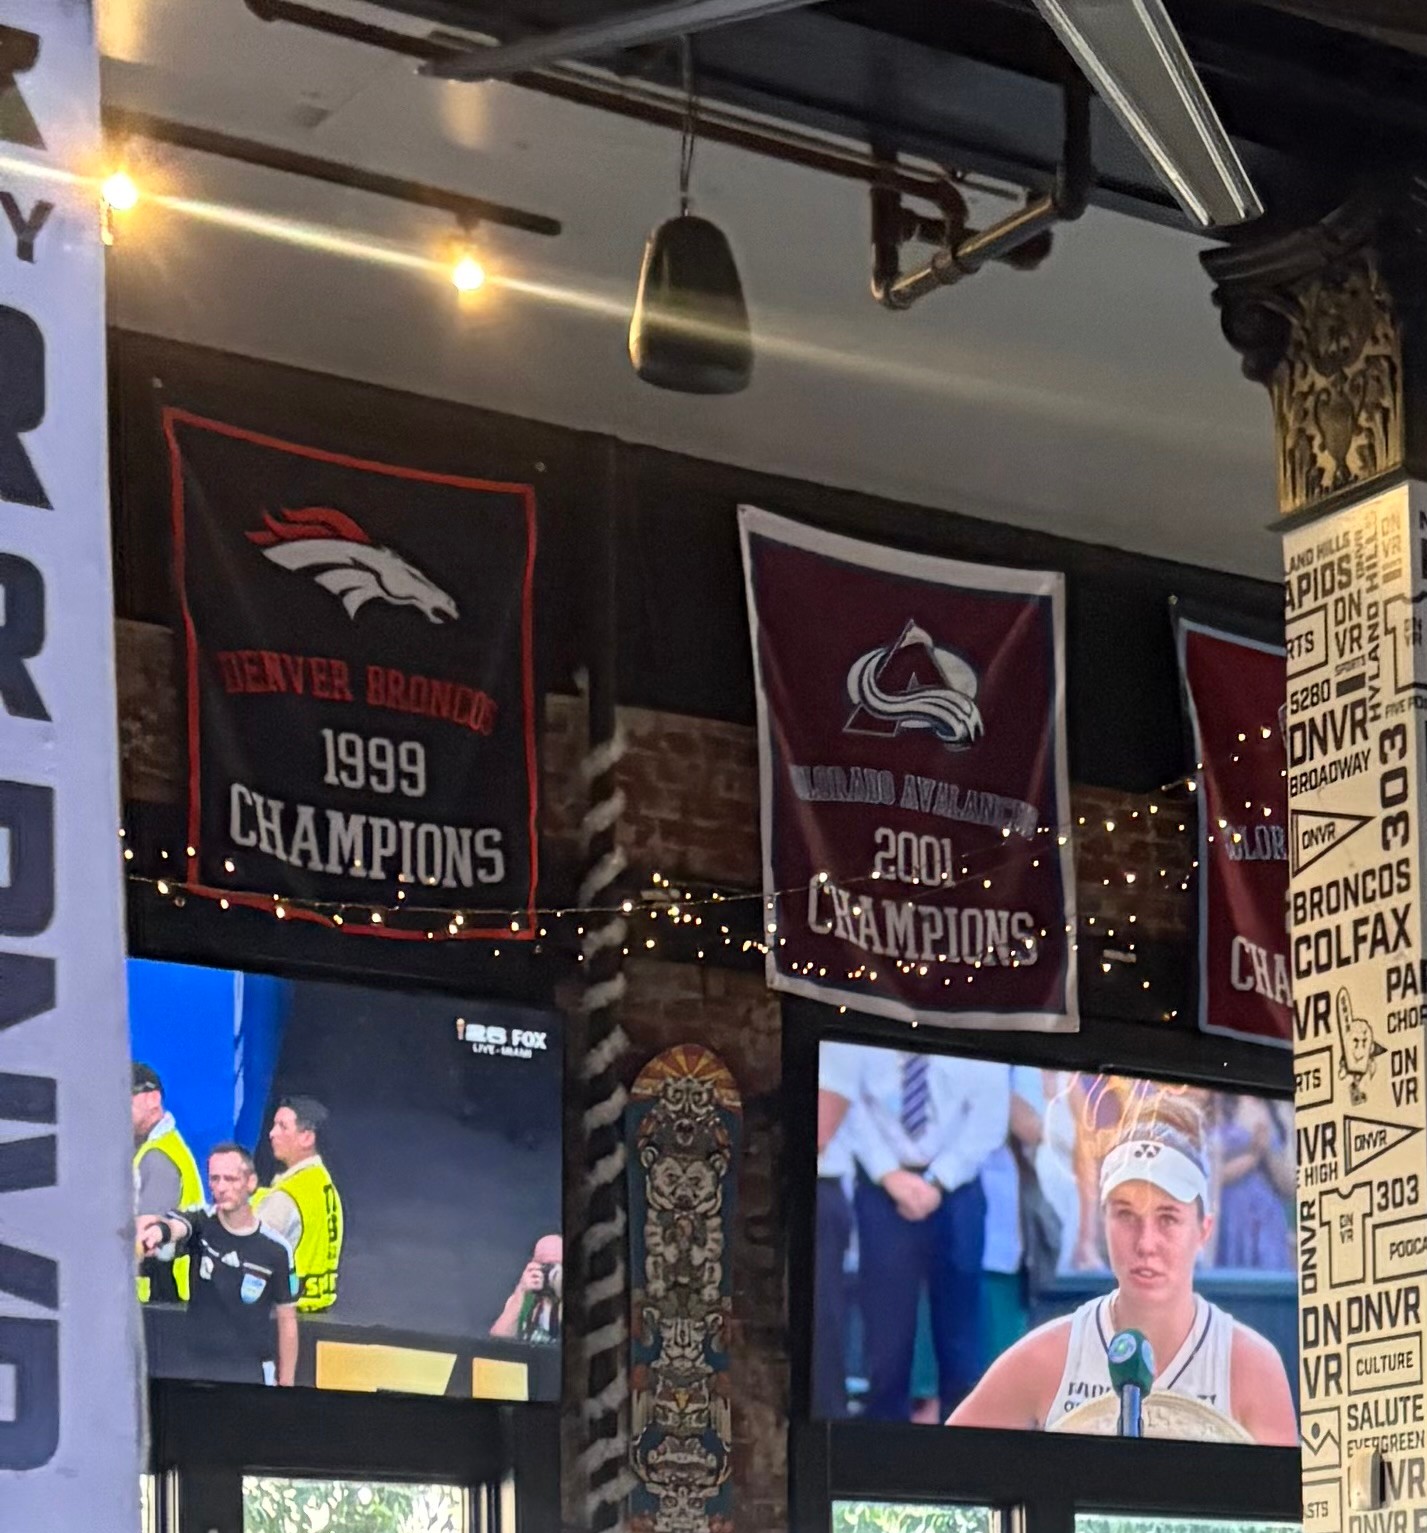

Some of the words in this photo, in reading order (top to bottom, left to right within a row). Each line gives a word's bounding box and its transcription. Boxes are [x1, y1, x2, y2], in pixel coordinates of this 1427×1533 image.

[217, 650, 353, 702] DENVER
[1290, 678, 1330, 715] 5280
[1289, 699, 1369, 767] DNVR
[321, 728, 426, 797] 1999
[1289, 749, 1371, 797] BROADWAY
[1380, 724, 1409, 851] 303
[230, 783, 505, 888] CHAMPIONS
[874, 827, 956, 887] 2001
[808, 874, 1038, 966] CHAMPIONS
[1293, 857, 1411, 927] BRONCOS
[1294, 903, 1412, 981] COLFAX
[512, 1029, 547, 1050] FOX
[1377, 1174, 1419, 1212] 303
[1347, 1286, 1421, 1337] DNVR
[1356, 1352, 1414, 1377] CULTURE
[1347, 1395, 1424, 1431] SALUTE
